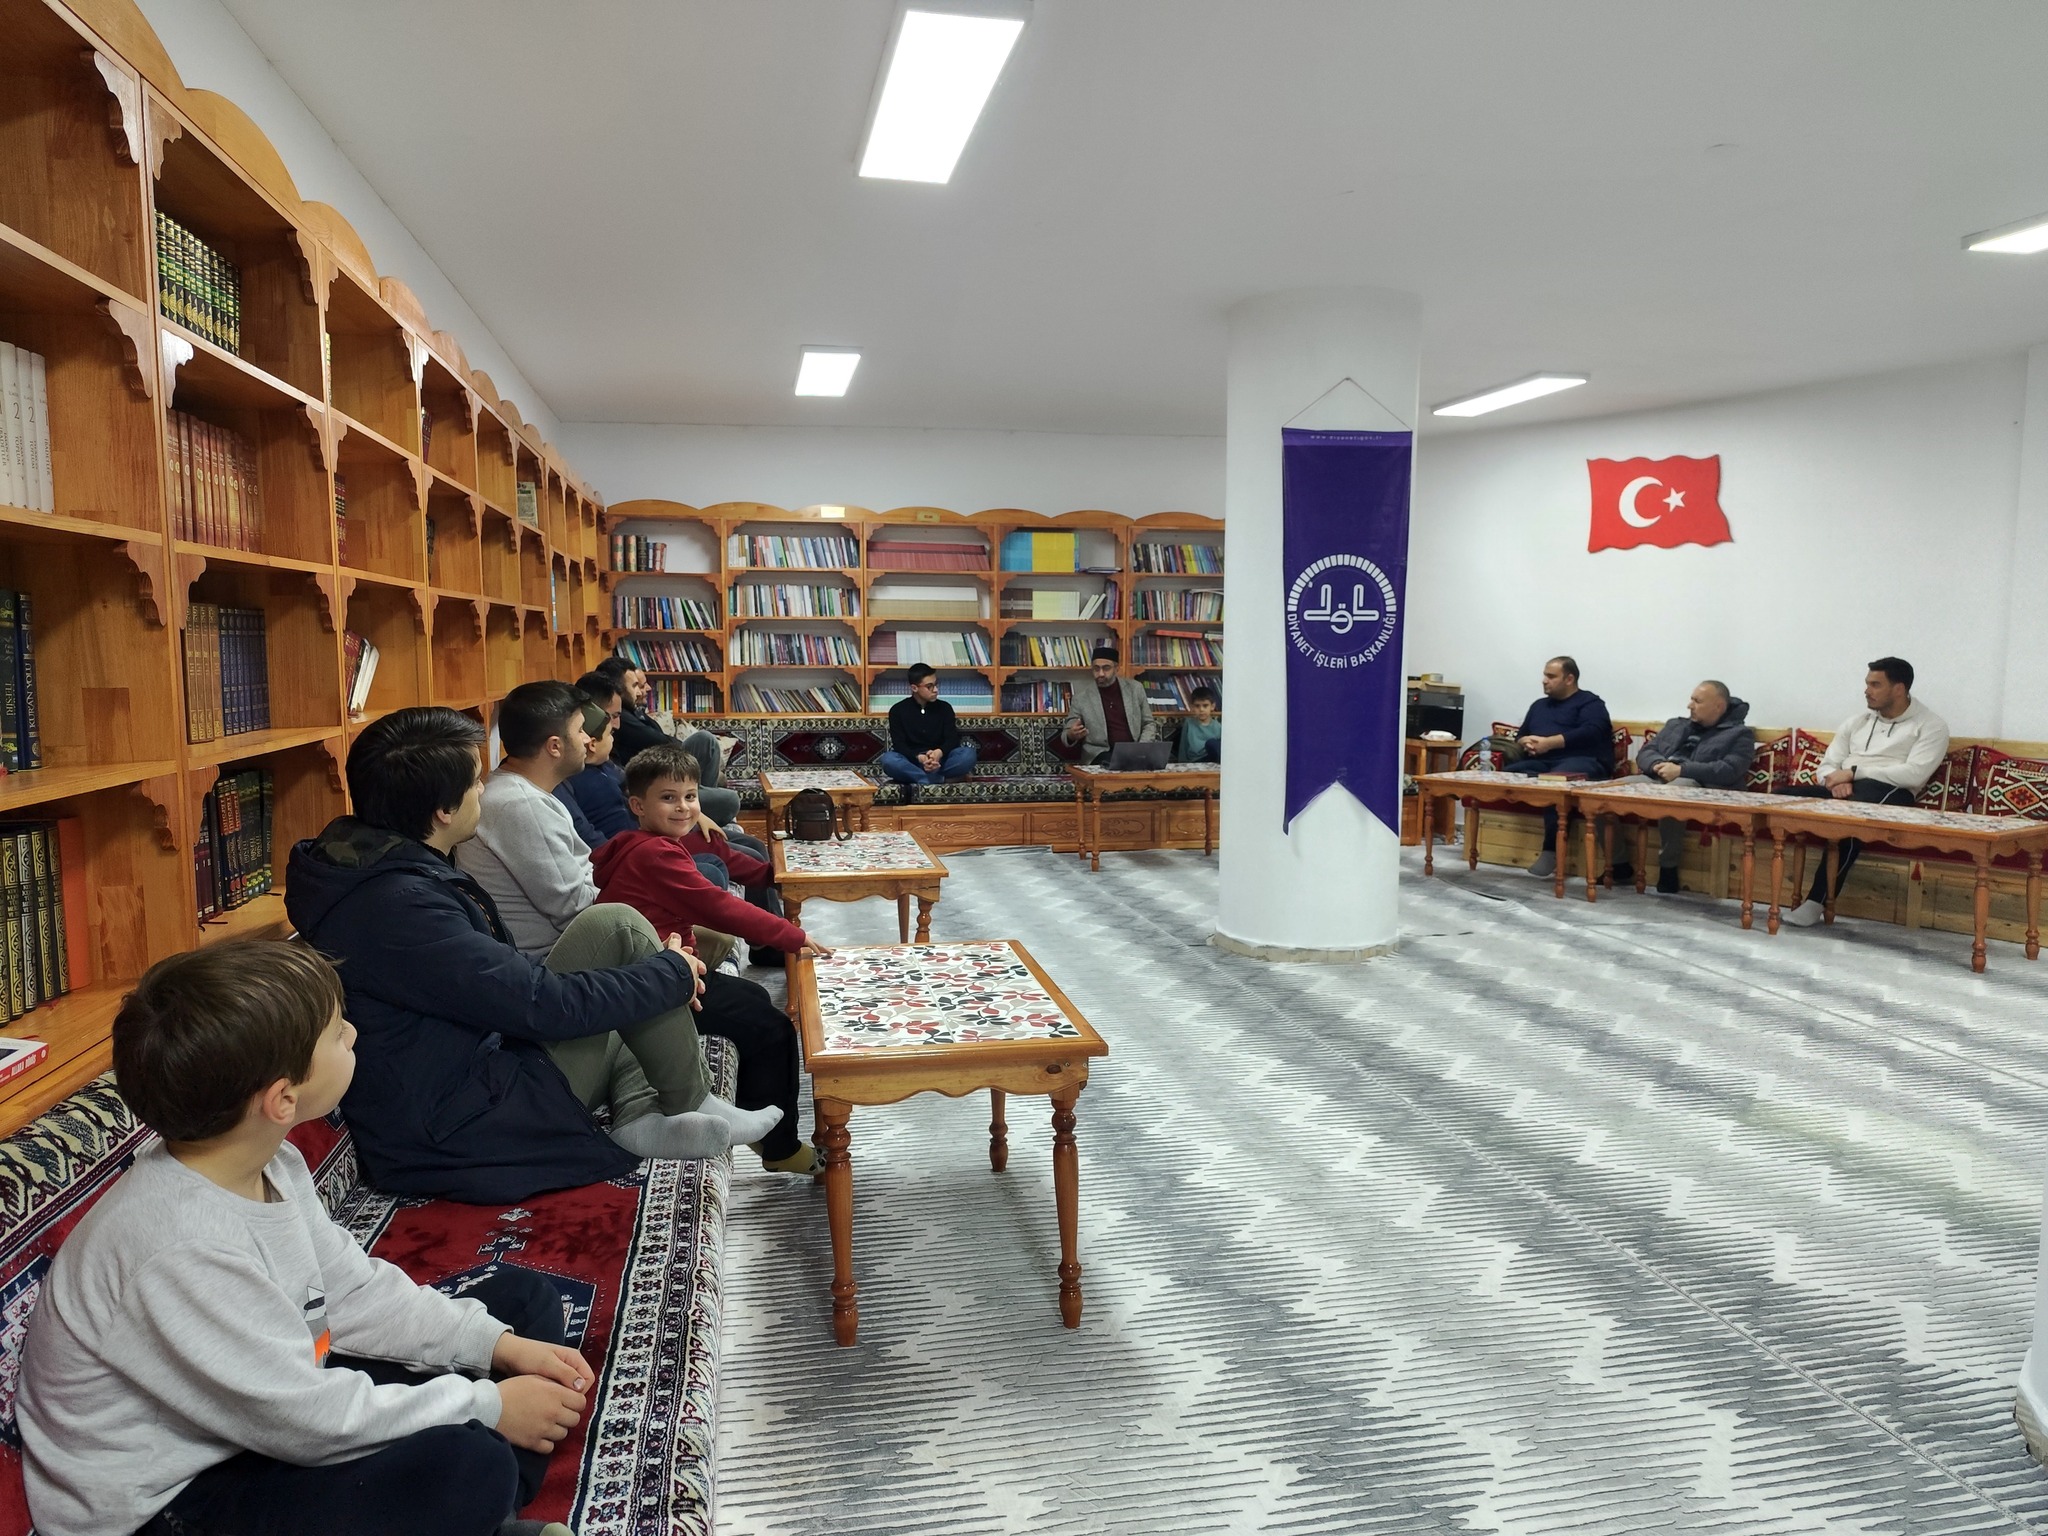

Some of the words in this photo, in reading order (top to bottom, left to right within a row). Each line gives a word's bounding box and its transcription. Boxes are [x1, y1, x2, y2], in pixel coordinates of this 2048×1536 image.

[1287, 613, 1315, 657] DİYANET
[1313, 650, 1348, 669] İŞLERİ
[1350, 613, 1397, 667] BAŞKANLIĞI
[25, 662, 33, 689] YOLU
